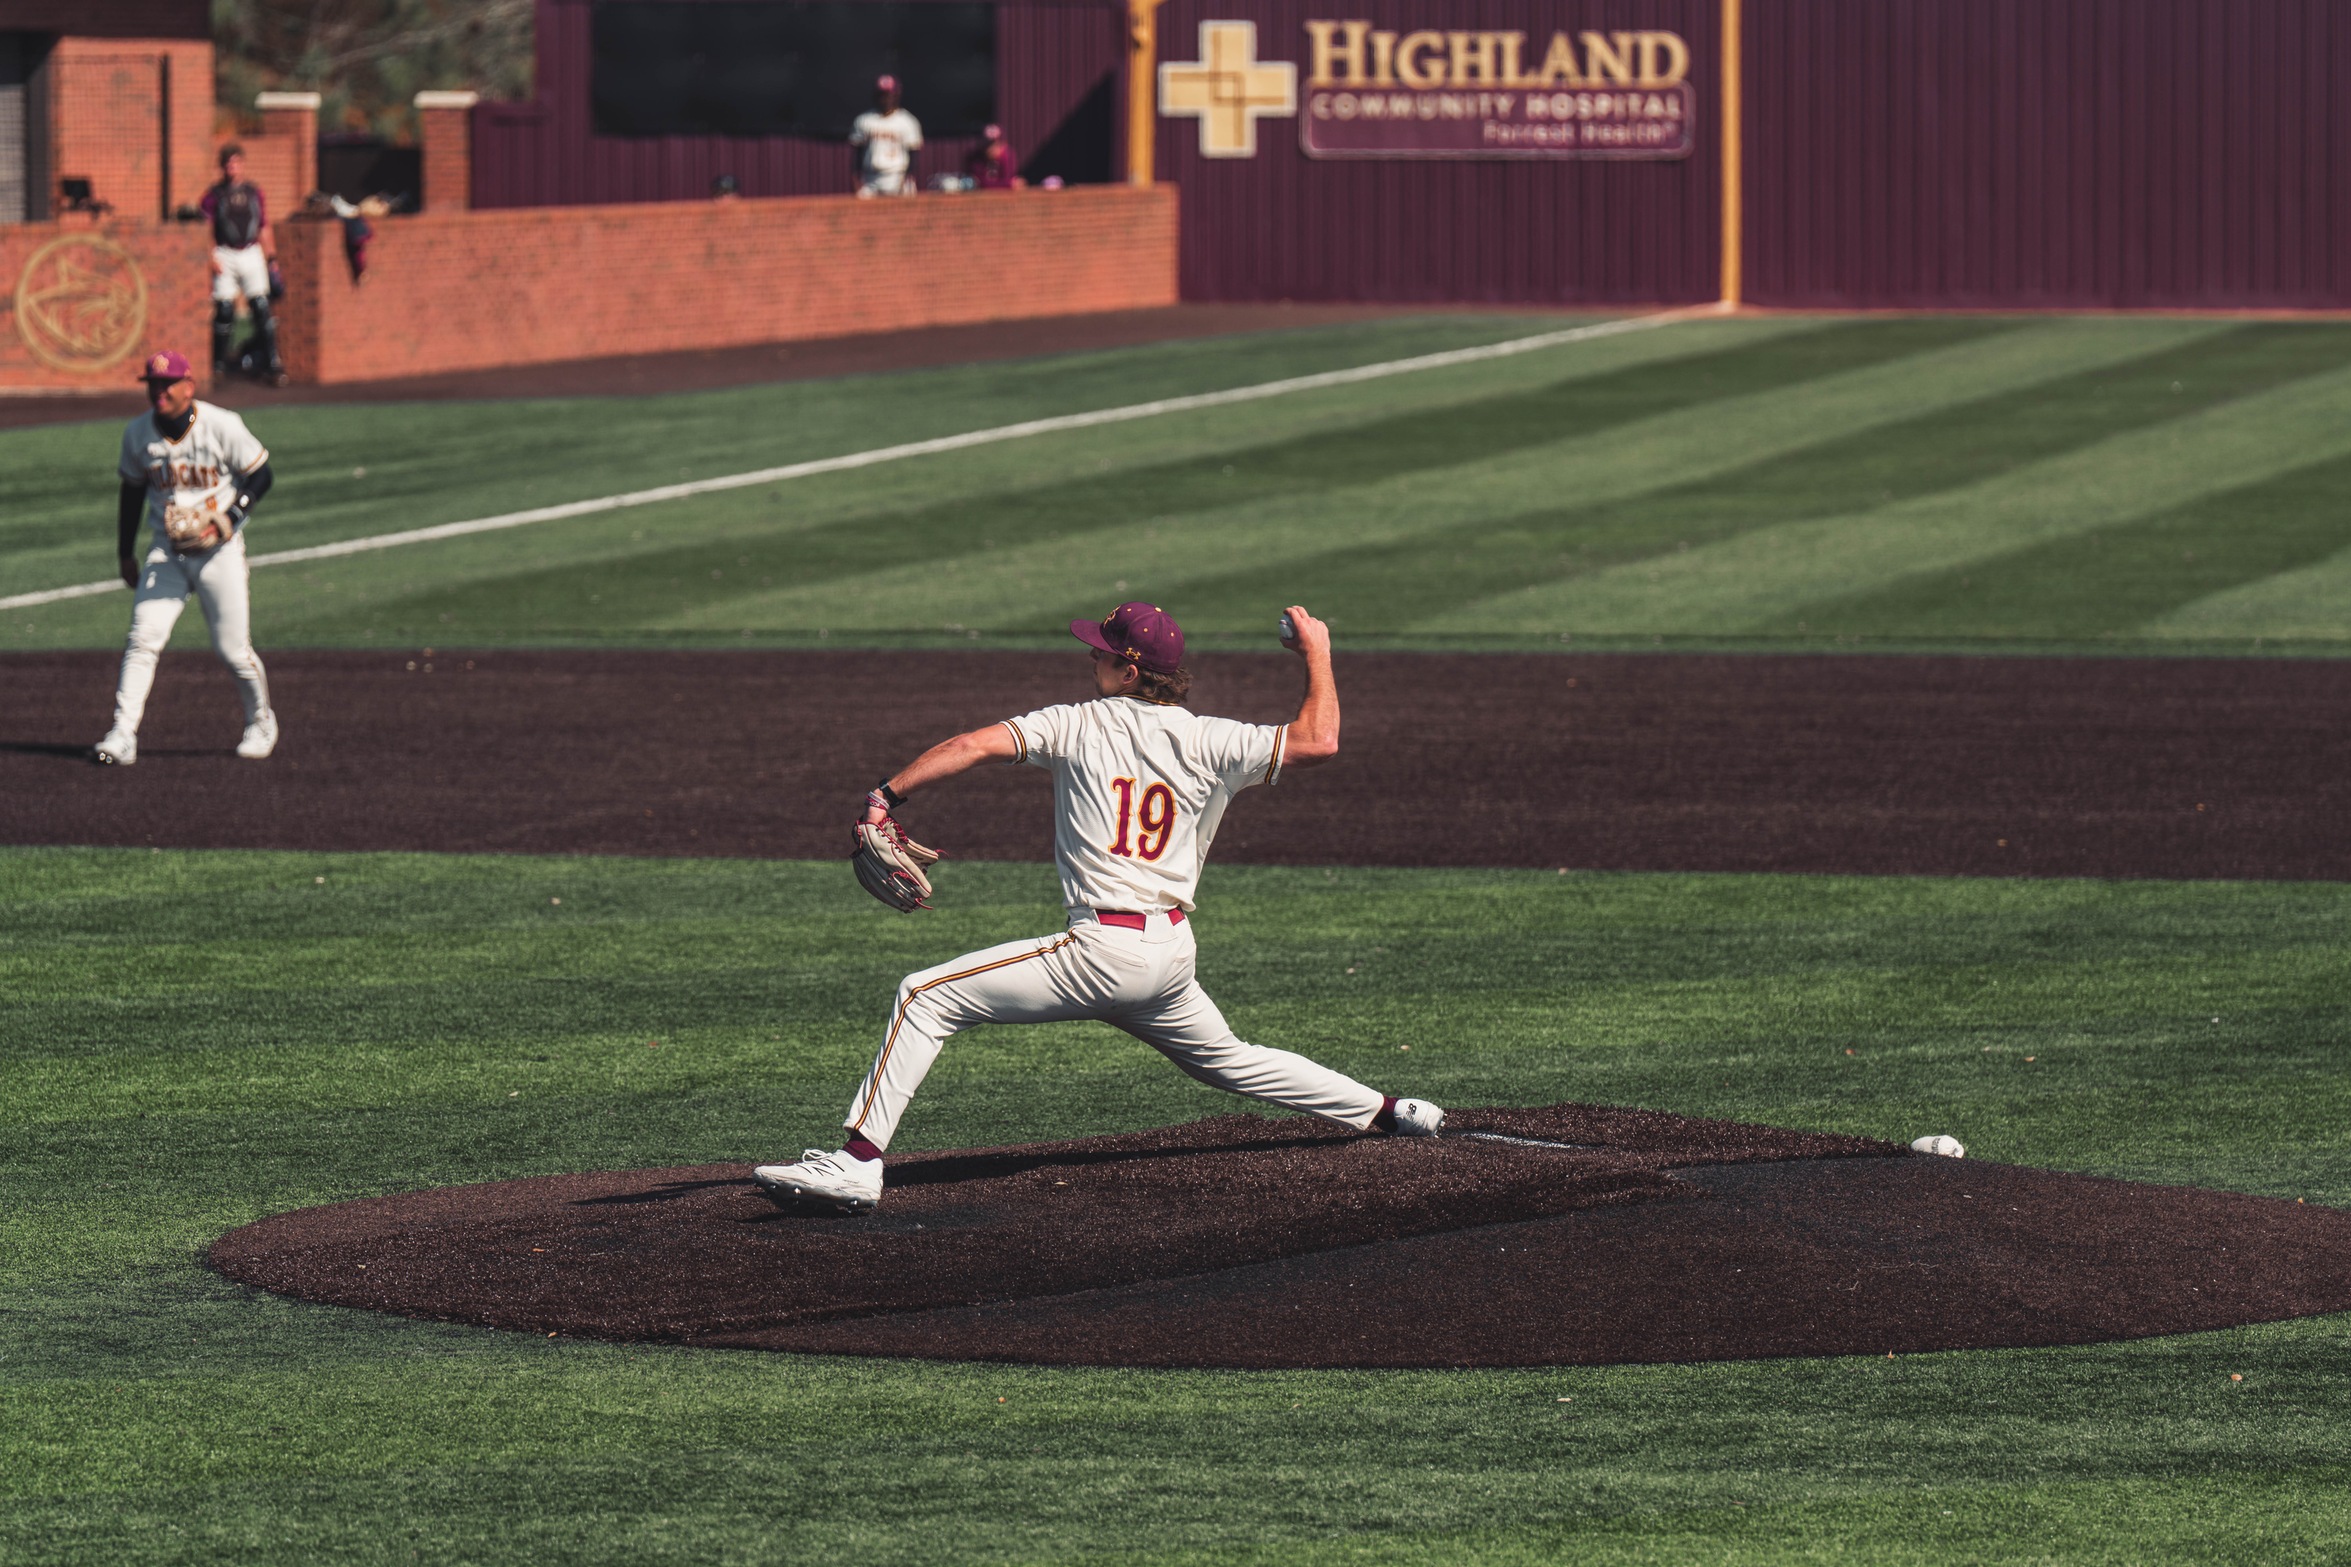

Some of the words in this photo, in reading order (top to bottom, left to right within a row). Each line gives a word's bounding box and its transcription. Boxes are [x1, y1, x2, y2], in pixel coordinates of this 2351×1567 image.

[1306, 21, 1688, 88] HIGHLAND
[1312, 93, 1516, 120] COMMUNITY
[1526, 93, 1682, 120] HOSPITAL
[1109, 776, 1178, 862] 19
